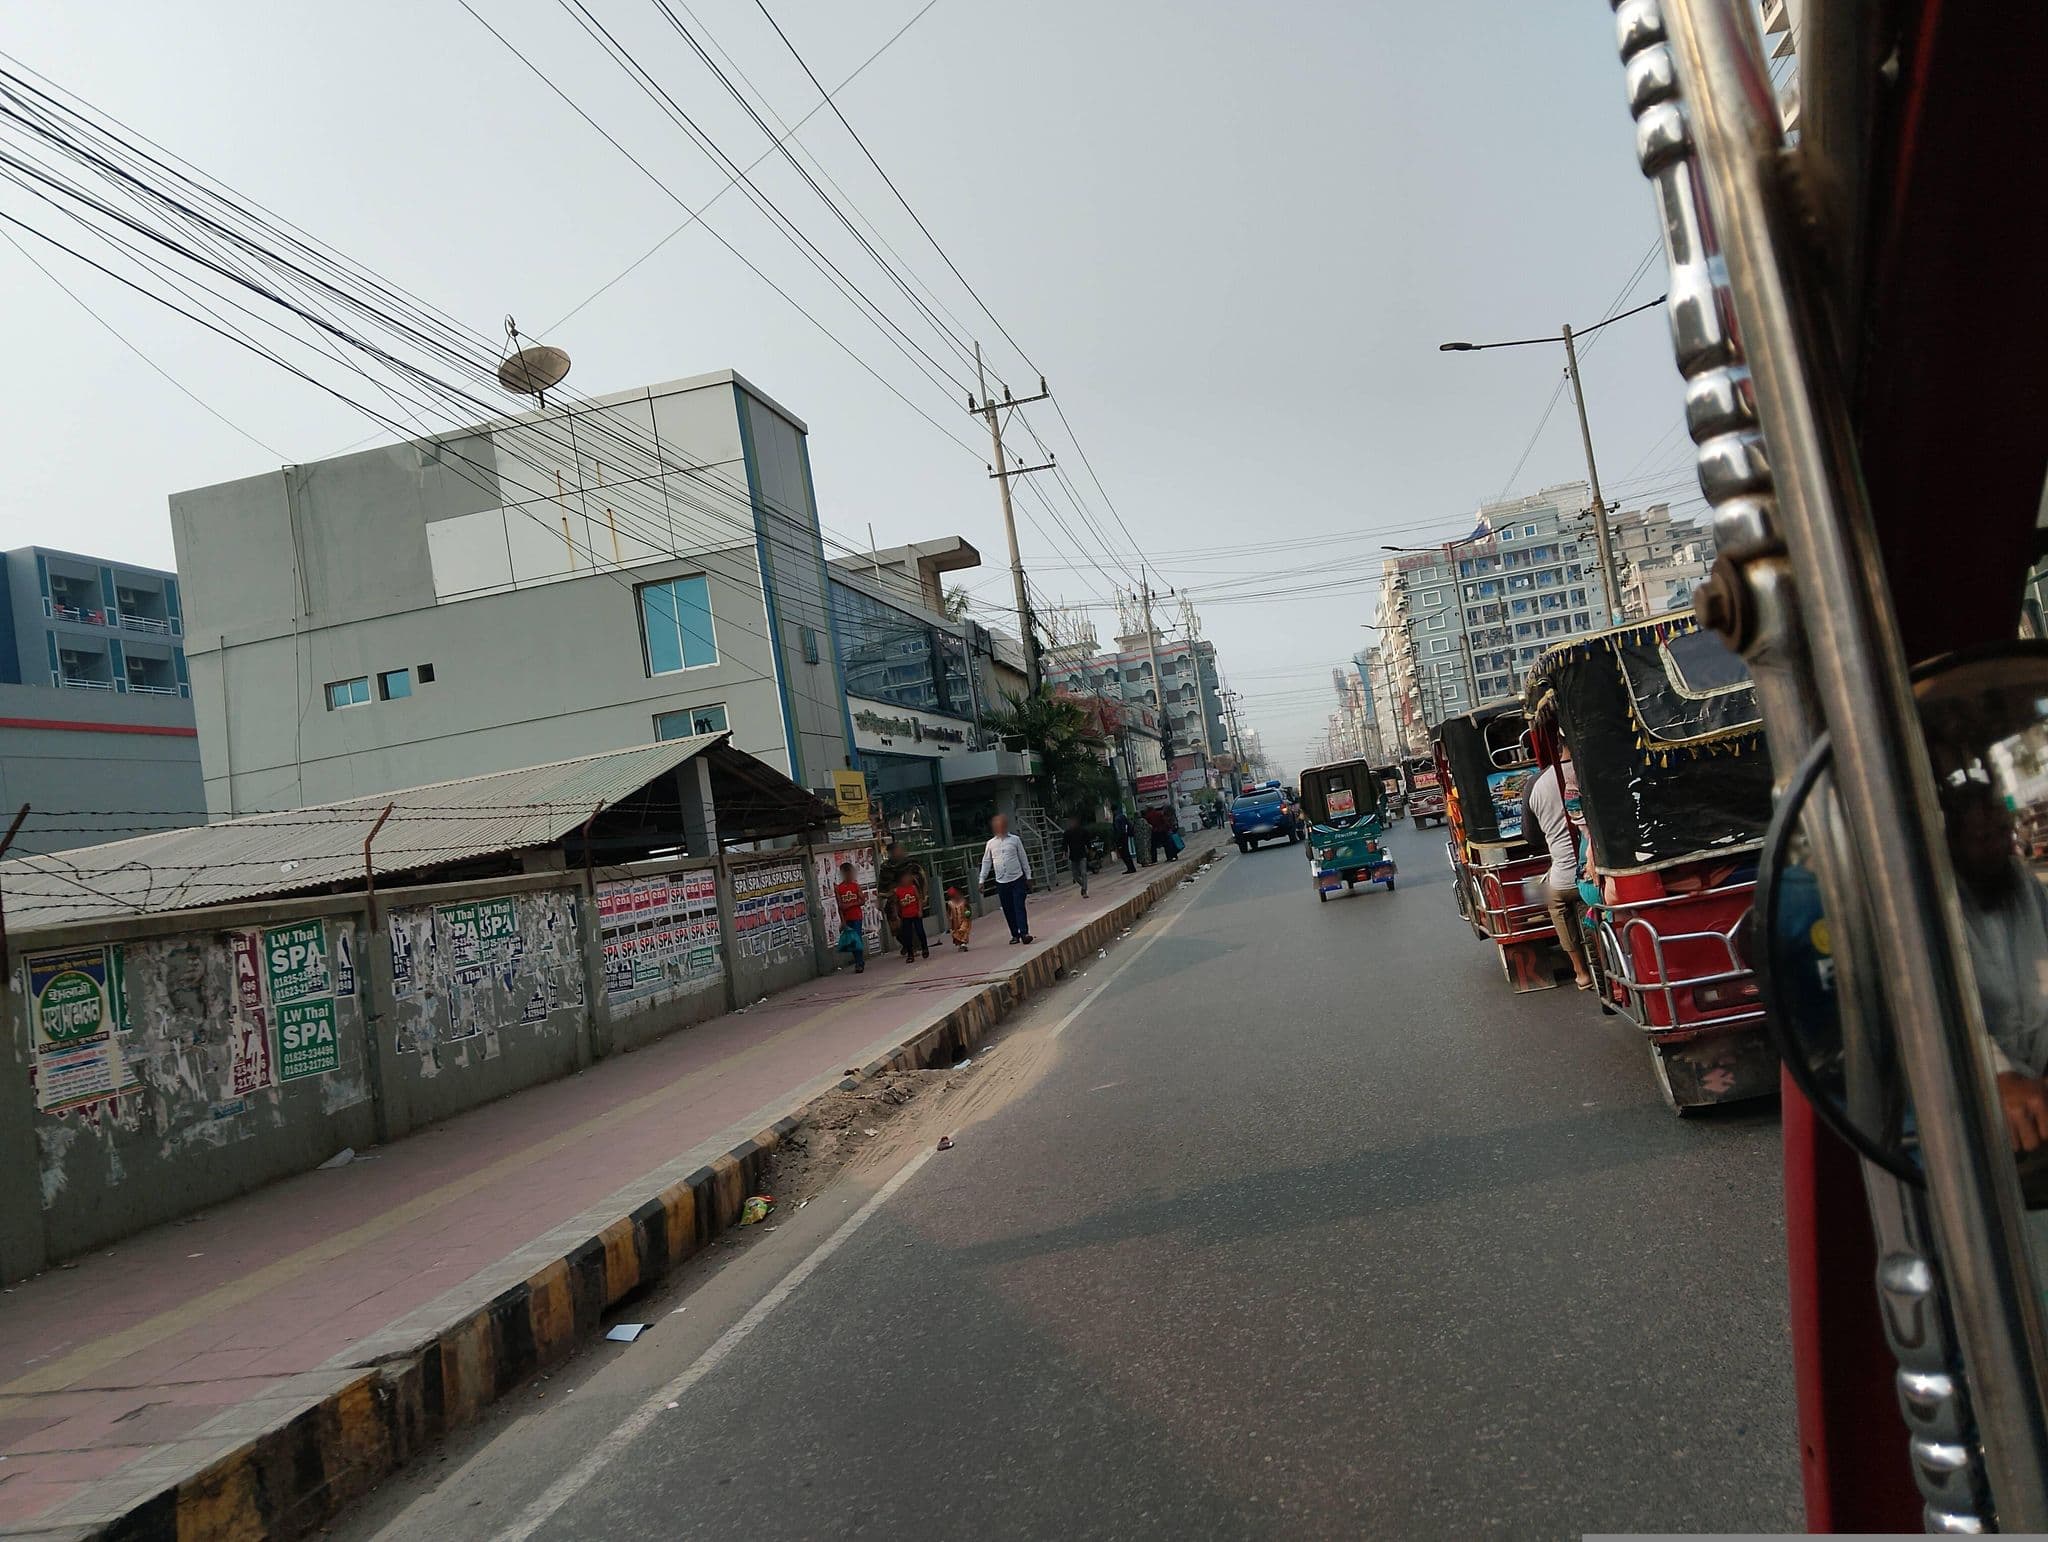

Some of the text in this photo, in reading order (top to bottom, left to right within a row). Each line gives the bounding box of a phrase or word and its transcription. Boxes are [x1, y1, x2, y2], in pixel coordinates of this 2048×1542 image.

[760, 874, 773, 888] SPA
[771, 872, 784, 885] SPA
[783, 870, 795, 884] SPA
[793, 869, 804, 882] SPA
[736, 880, 748, 893] SPA
[748, 877, 761, 891] SPA
[671, 888, 686, 904] SPA
[457, 907, 475, 921] Thai
[493, 902, 511, 915] Thai
[271, 926, 318, 948] LW Thai
[675, 928, 690, 945] SPA
[692, 923, 706, 940] SPA
[707, 921, 721, 937] SPA
[640, 936, 657, 954] SPA
[659, 932, 674, 949] SPA
[271, 941, 321, 973] SPA
[603, 945, 619, 963] SPA
[622, 941, 638, 958] SPA
[464, 967, 483, 981] Thai
[284, 1004, 329, 1024] LW Thai
[283, 1019, 334, 1049] SPA
